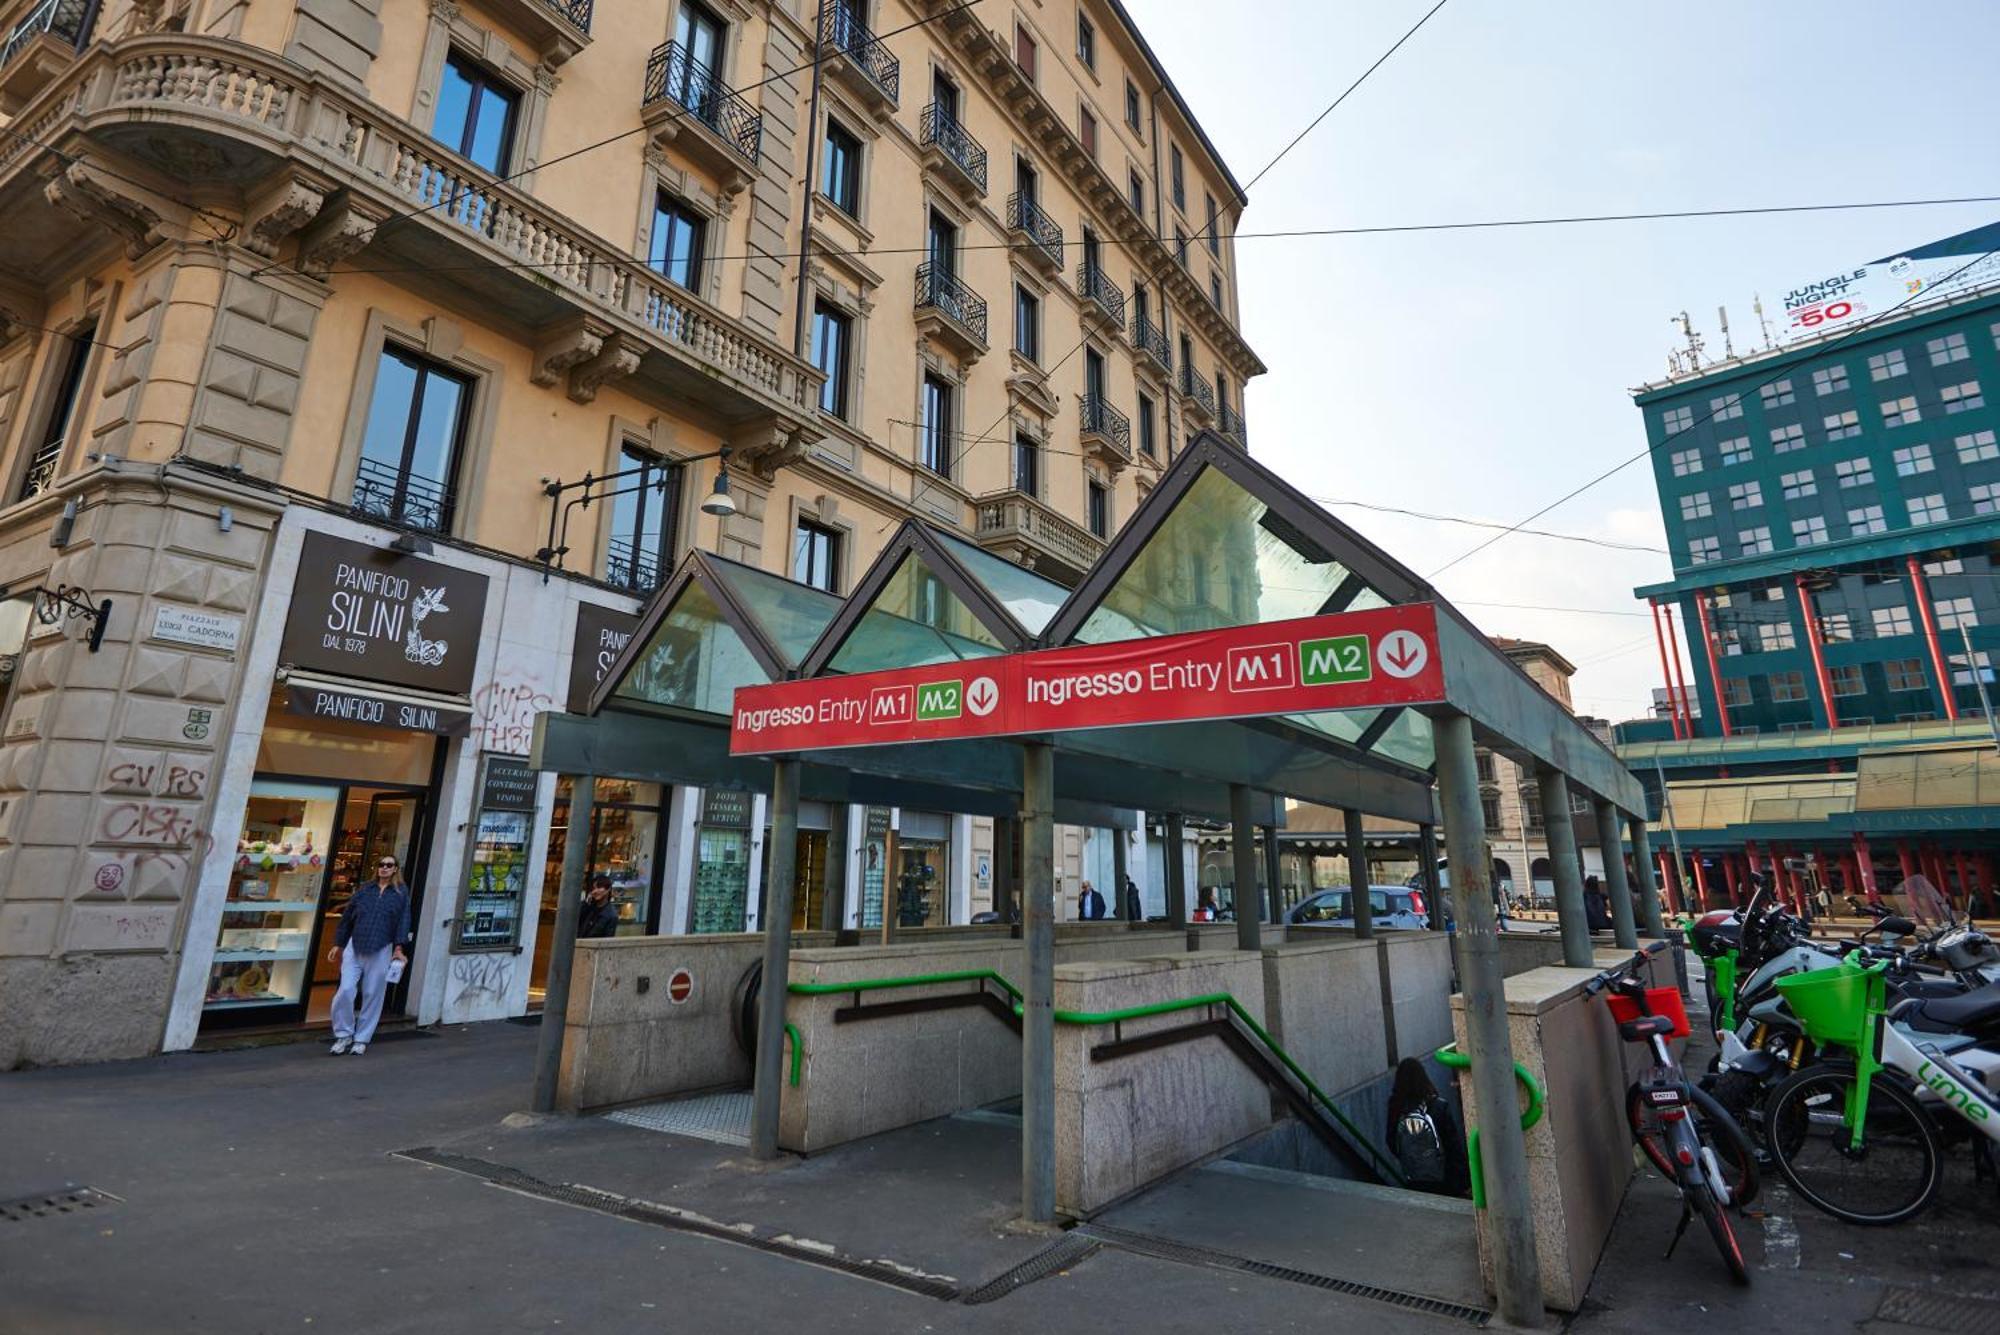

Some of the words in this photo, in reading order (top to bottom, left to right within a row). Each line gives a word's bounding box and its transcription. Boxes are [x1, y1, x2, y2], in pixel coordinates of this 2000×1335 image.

[1783, 268, 1868, 301] JUNGLE
[1785, 283, 1850, 310] NIGHT
[335, 563, 409, 601] PANIFICIO
[188, 625, 235, 641] CADORNA
[327, 591, 405, 642] SILINI
[322, 633, 341, 650] DAL
[345, 638, 366, 655] 1978
[600, 629, 632, 651] PANIF
[1027, 669, 1142, 706] Ingresso
[1150, 660, 1222, 691] Entry
[1235, 652, 1283, 682] M1
[1307, 645, 1363, 676] M2
[314, 692, 384, 723] PANIFICIO
[399, 706, 437, 730] SILINI
[737, 703, 814, 733] Ingresso
[818, 698, 868, 724] Entry
[874, 693, 906, 717] M1
[921, 688, 957, 712] M2
[487, 780, 534, 791] CONTROLLO
[1917, 1061, 1989, 1121] Lime
